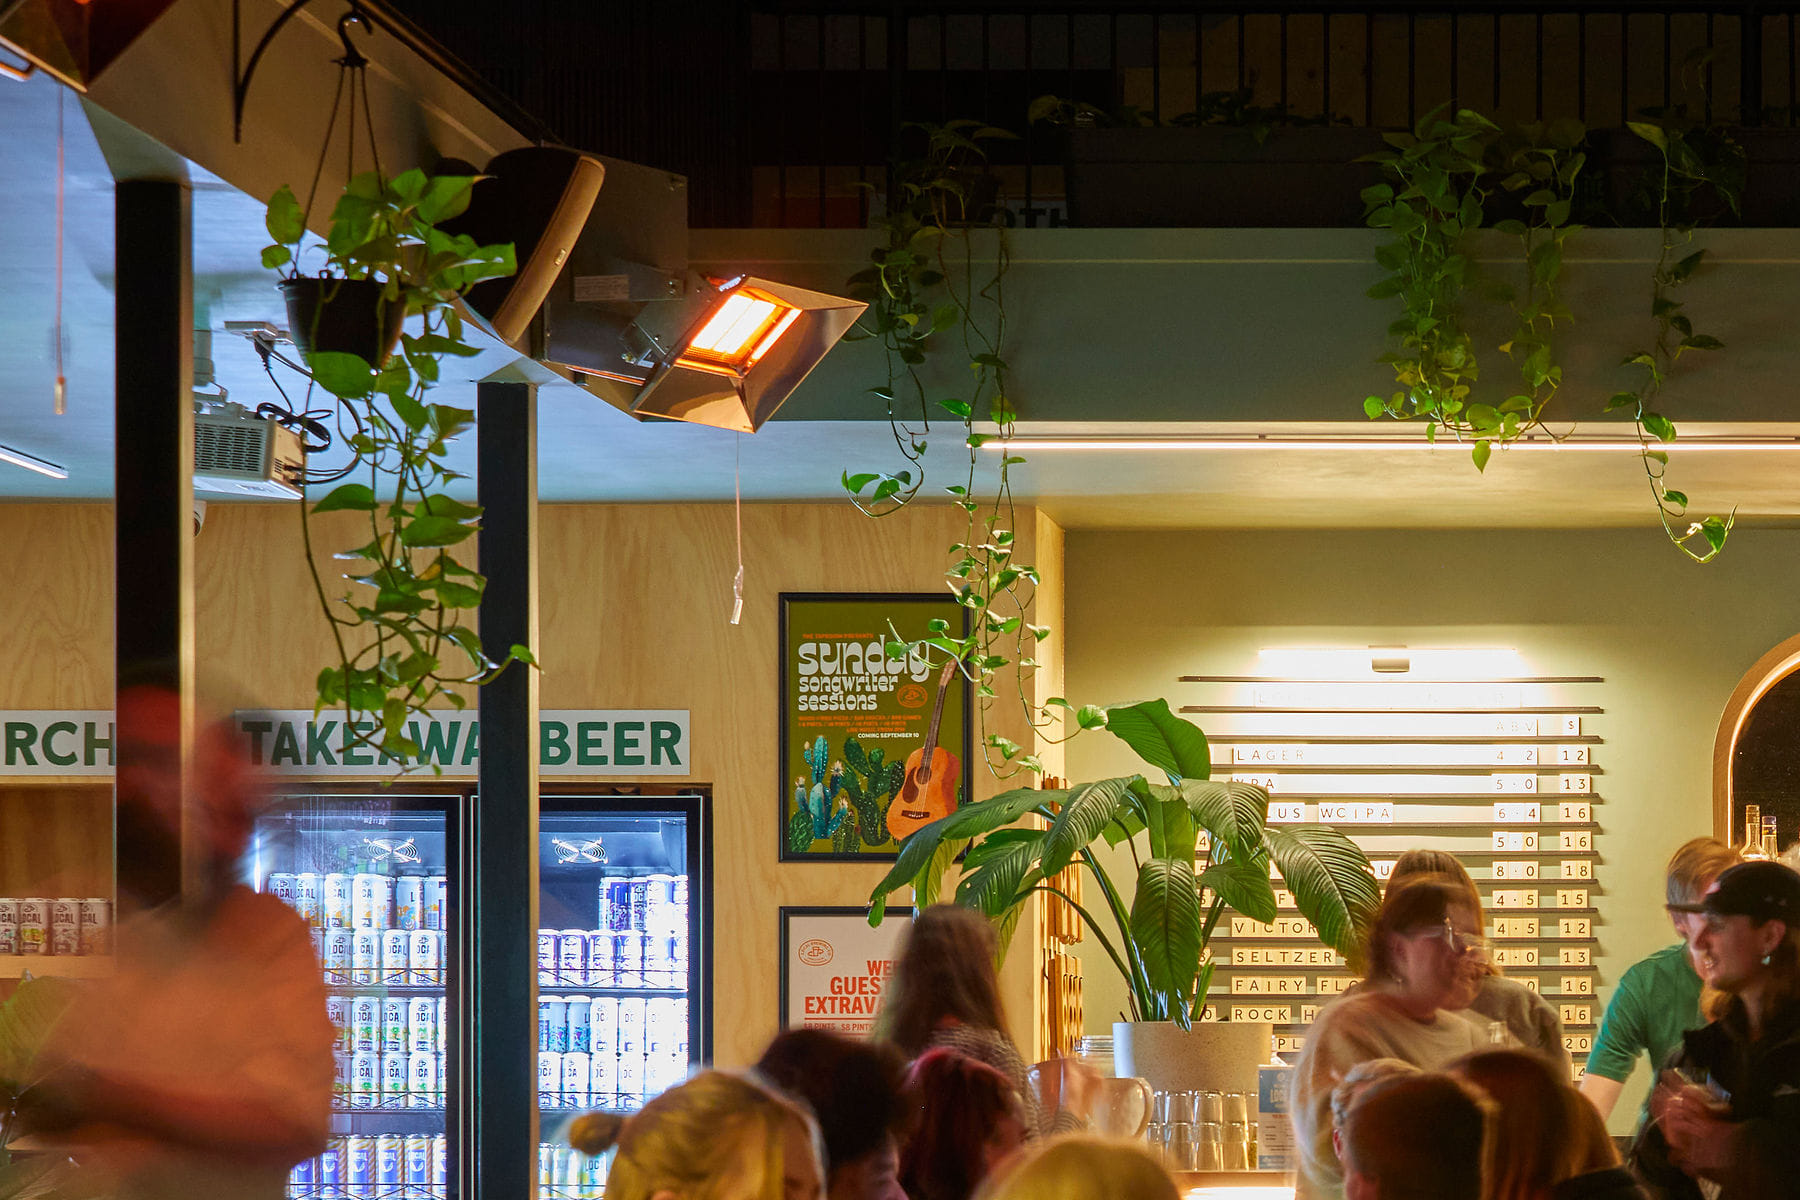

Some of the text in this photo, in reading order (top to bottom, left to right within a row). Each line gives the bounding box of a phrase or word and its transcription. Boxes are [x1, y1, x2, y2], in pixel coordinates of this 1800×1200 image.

[798, 634, 930, 682] sunday
[798, 672, 899, 698] songwriter
[798, 693, 878, 711] sessions
[242, 721, 683, 766] TAKEAWA BEER
[1236, 750, 1305, 761] LAGER
[1563, 750, 1584, 761] 12
[1564, 779, 1586, 790] 13
[1565, 807, 1586, 818] 16
[1564, 836, 1587, 847] 16
[1565, 865, 1588, 876] 18
[1561, 894, 1583, 905] 15
[1564, 923, 1586, 934] 12
[1236, 951, 1333, 963] SELTZER
[1564, 952, 1586, 963] 13
[830, 976, 893, 996] GUEST
[1235, 980, 1304, 992] FAIRY
[1565, 981, 1588, 992] 16
[1235, 1009, 1288, 1020] ROCK
[1564, 1009, 1586, 1021] 16
[1565, 1038, 1588, 1049] 20
